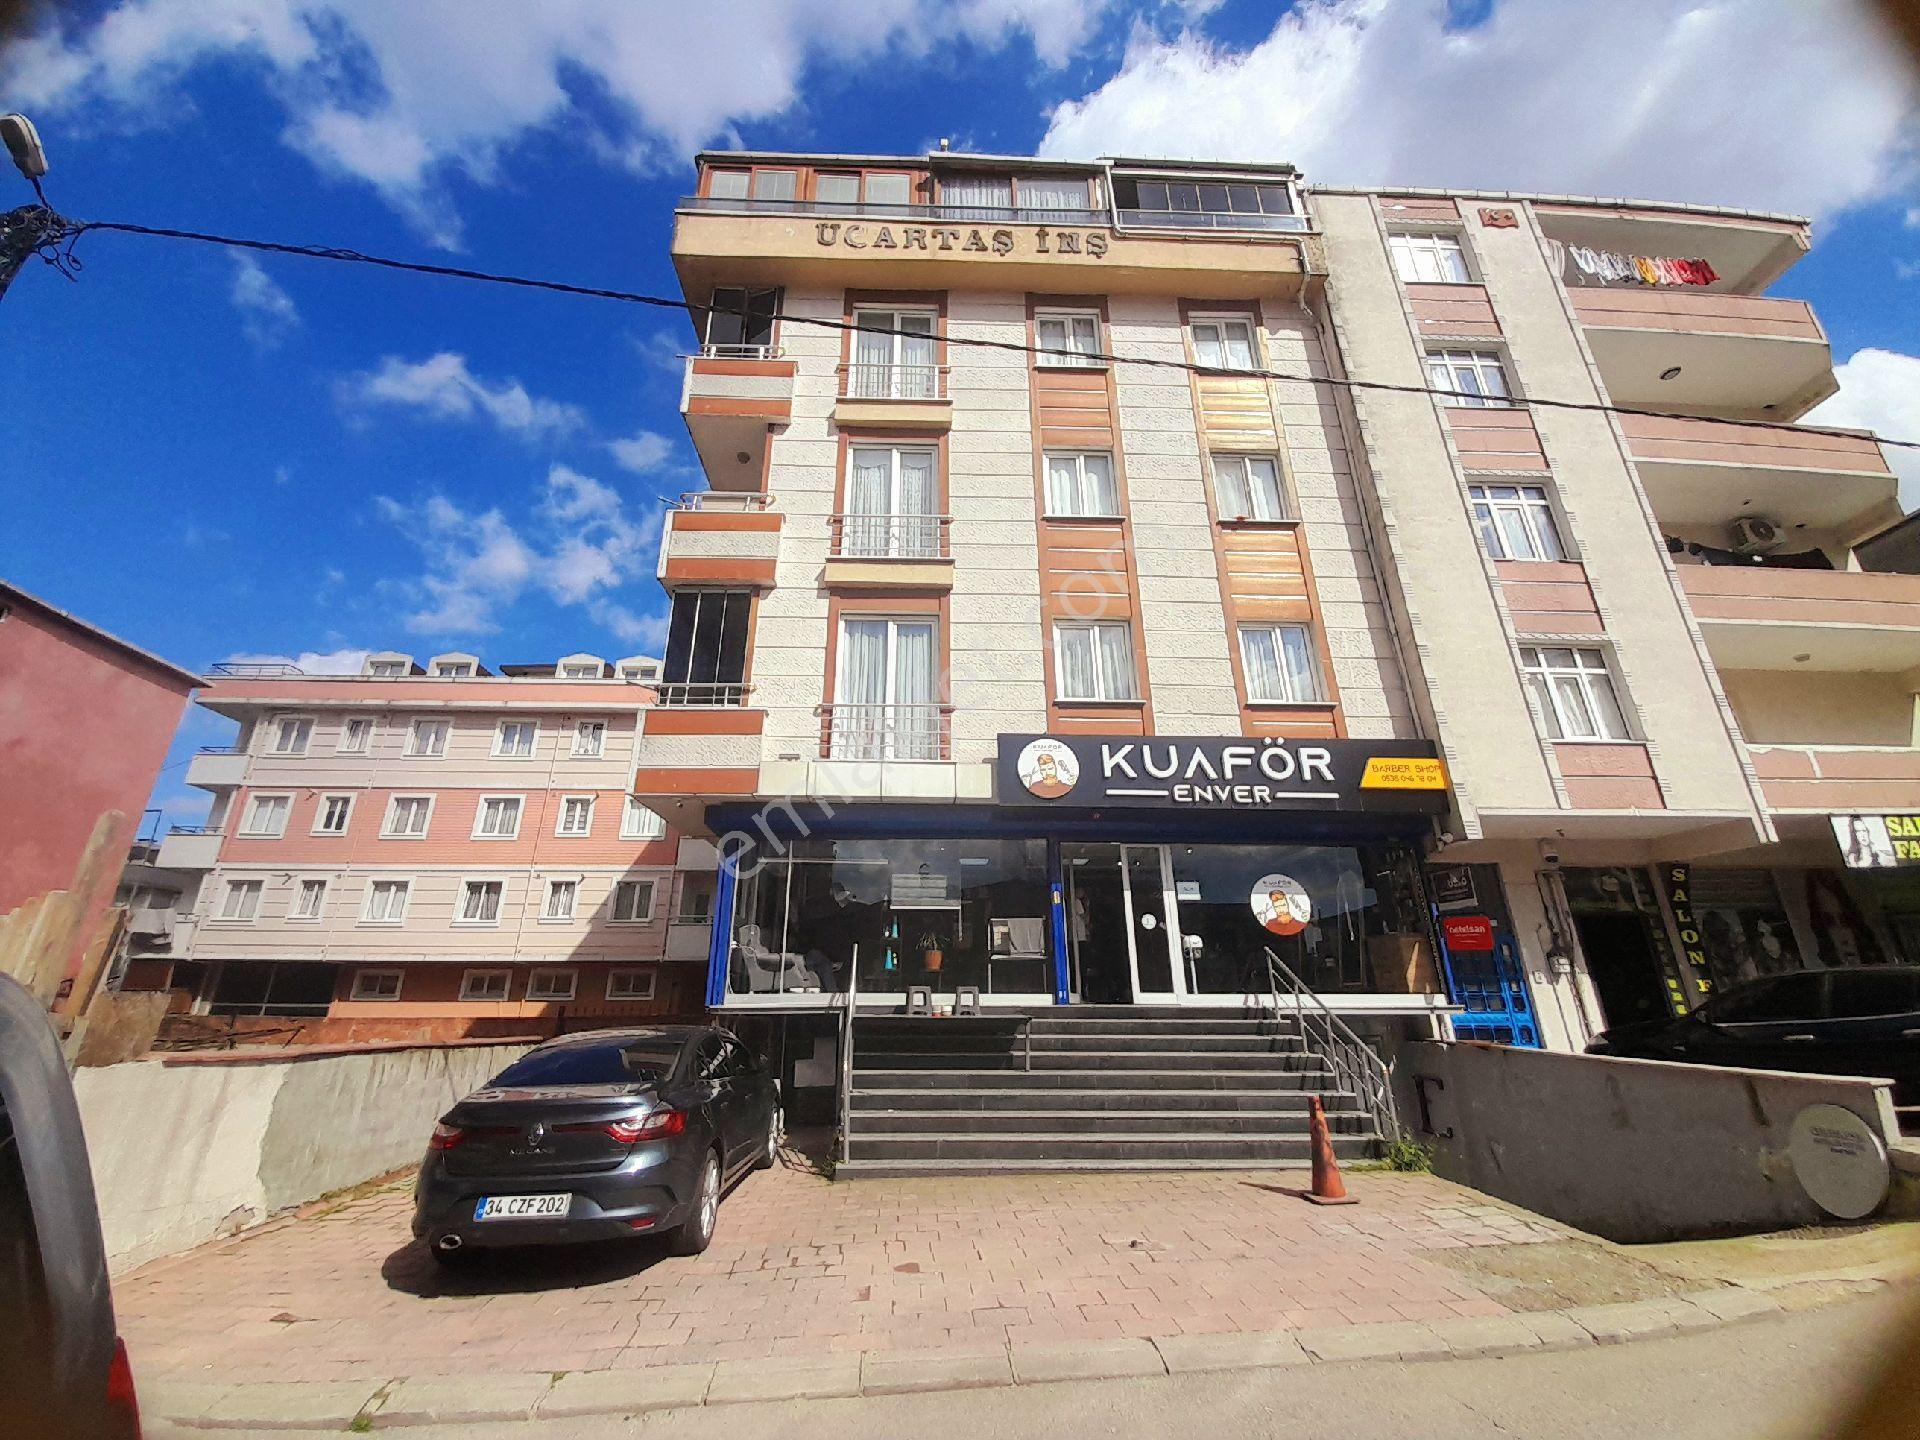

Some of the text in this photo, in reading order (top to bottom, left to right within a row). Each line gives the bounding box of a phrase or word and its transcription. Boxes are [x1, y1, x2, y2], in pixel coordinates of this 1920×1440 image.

[1035, 226, 1108, 259] İNŞ
[1101, 736, 1336, 781] KUAFÖR
[1372, 764, 1410, 773] BARBER
[1172, 784, 1272, 803] ENVER
[1671, 867, 1706, 966] SALON
[485, 1196, 565, 1216] 34 CZF 202
